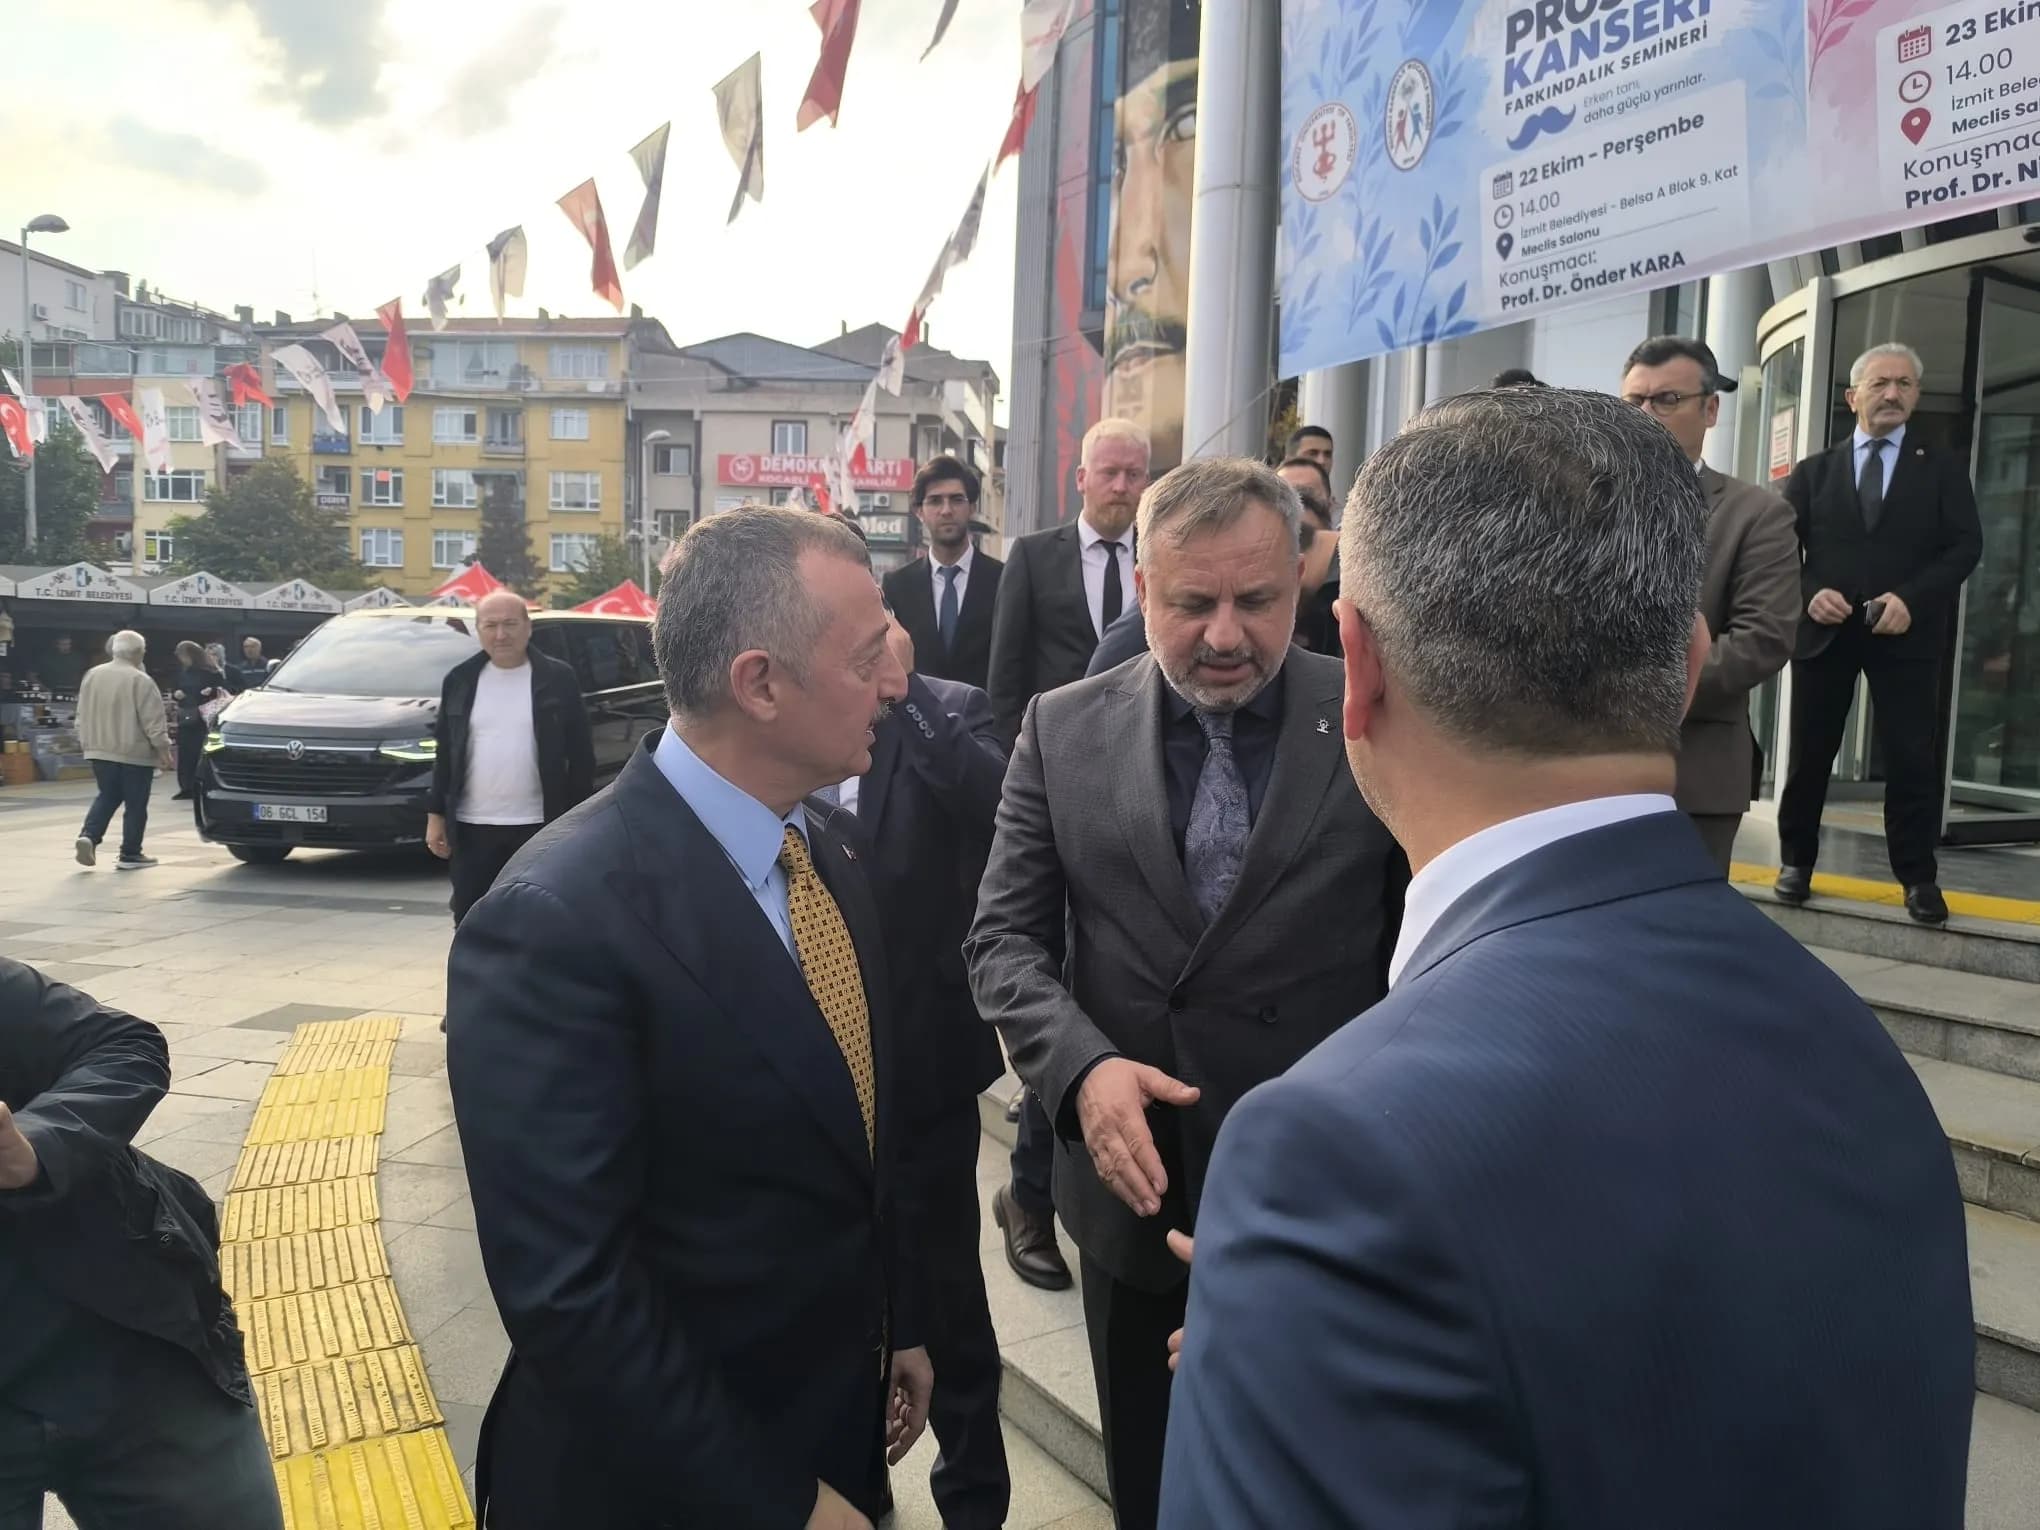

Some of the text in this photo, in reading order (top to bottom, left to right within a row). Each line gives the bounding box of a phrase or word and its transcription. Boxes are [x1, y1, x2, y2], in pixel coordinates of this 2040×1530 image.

[1505, 0, 1620, 55] PRO
[1945, 18, 1977, 47] 23
[1504, 19, 1708, 116] FARKINDALIK SEMİNERİ
[1946, 47, 2013, 85] 14.00
[1583, 72, 1707, 124] daha güçlü yarınlar.
[1951, 76, 2040, 111] İzmit Bele
[1952, 96, 2040, 134] Meclis Sa
[1519, 167, 1538, 188] 22
[1541, 154, 1585, 180] Ekim
[1602, 113, 1705, 160] Perşembe
[1519, 191, 1560, 217] 14.00
[1549, 202, 1608, 232] Belediyesi
[1619, 190, 1654, 210] Belsa
[1656, 186, 1666, 199] A
[1669, 177, 1697, 196] Blok
[1699, 173, 1711, 187] 9.
[1714, 164, 1739, 182] Kat
[1905, 155, 2040, 209] Prof. Dr. N
[1521, 227, 1600, 257] Meclis Salonu
[1499, 249, 1598, 288] Konuşmacı:
[1501, 250, 1686, 311] Prof. Dr. Önder KARA
